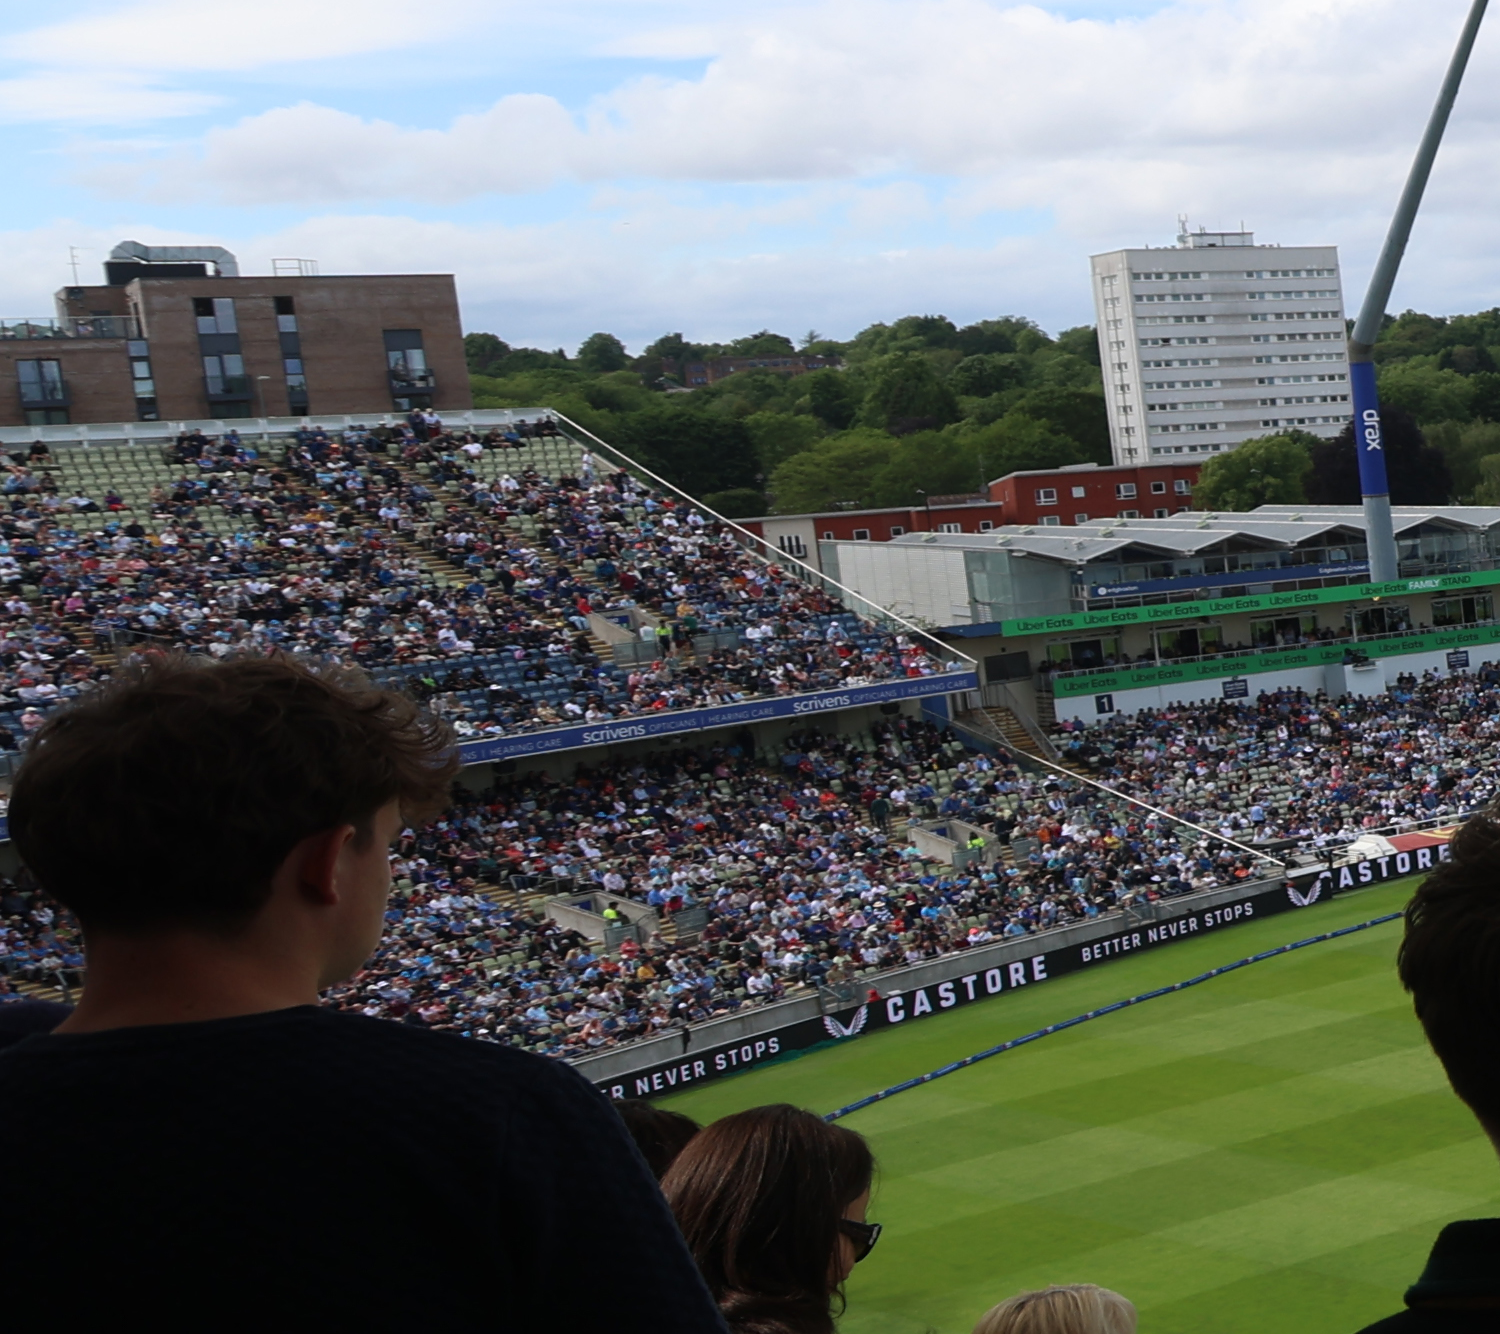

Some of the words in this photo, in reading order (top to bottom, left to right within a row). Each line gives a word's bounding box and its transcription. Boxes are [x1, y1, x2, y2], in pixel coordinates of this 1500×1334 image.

[1362, 409, 1382, 451] drax
[1361, 585, 1384, 596] Uber
[1408, 579, 1440, 590] FAMILY
[1442, 575, 1471, 586] STAND
[1017, 619, 1043, 631] Uber
[1046, 618, 1073, 629] Eats
[1102, 696, 1111, 713] 1
[582, 726, 646, 744] scrivens
[649, 718, 697, 732] OPTICIANS
[708, 711, 749, 724] HEARING
[751, 707, 775, 717] CARE
[490, 743, 534, 757] HEARING
[537, 738, 562, 751] CARE
[1082, 933, 1142, 963] BETTER
[1148, 917, 1198, 943] NEVER
[1204, 902, 1254, 927] STOPS
[886, 955, 1048, 1023] CASTORE
[636, 1060, 706, 1095] NEVER
[715, 1037, 780, 1071] STOPS
